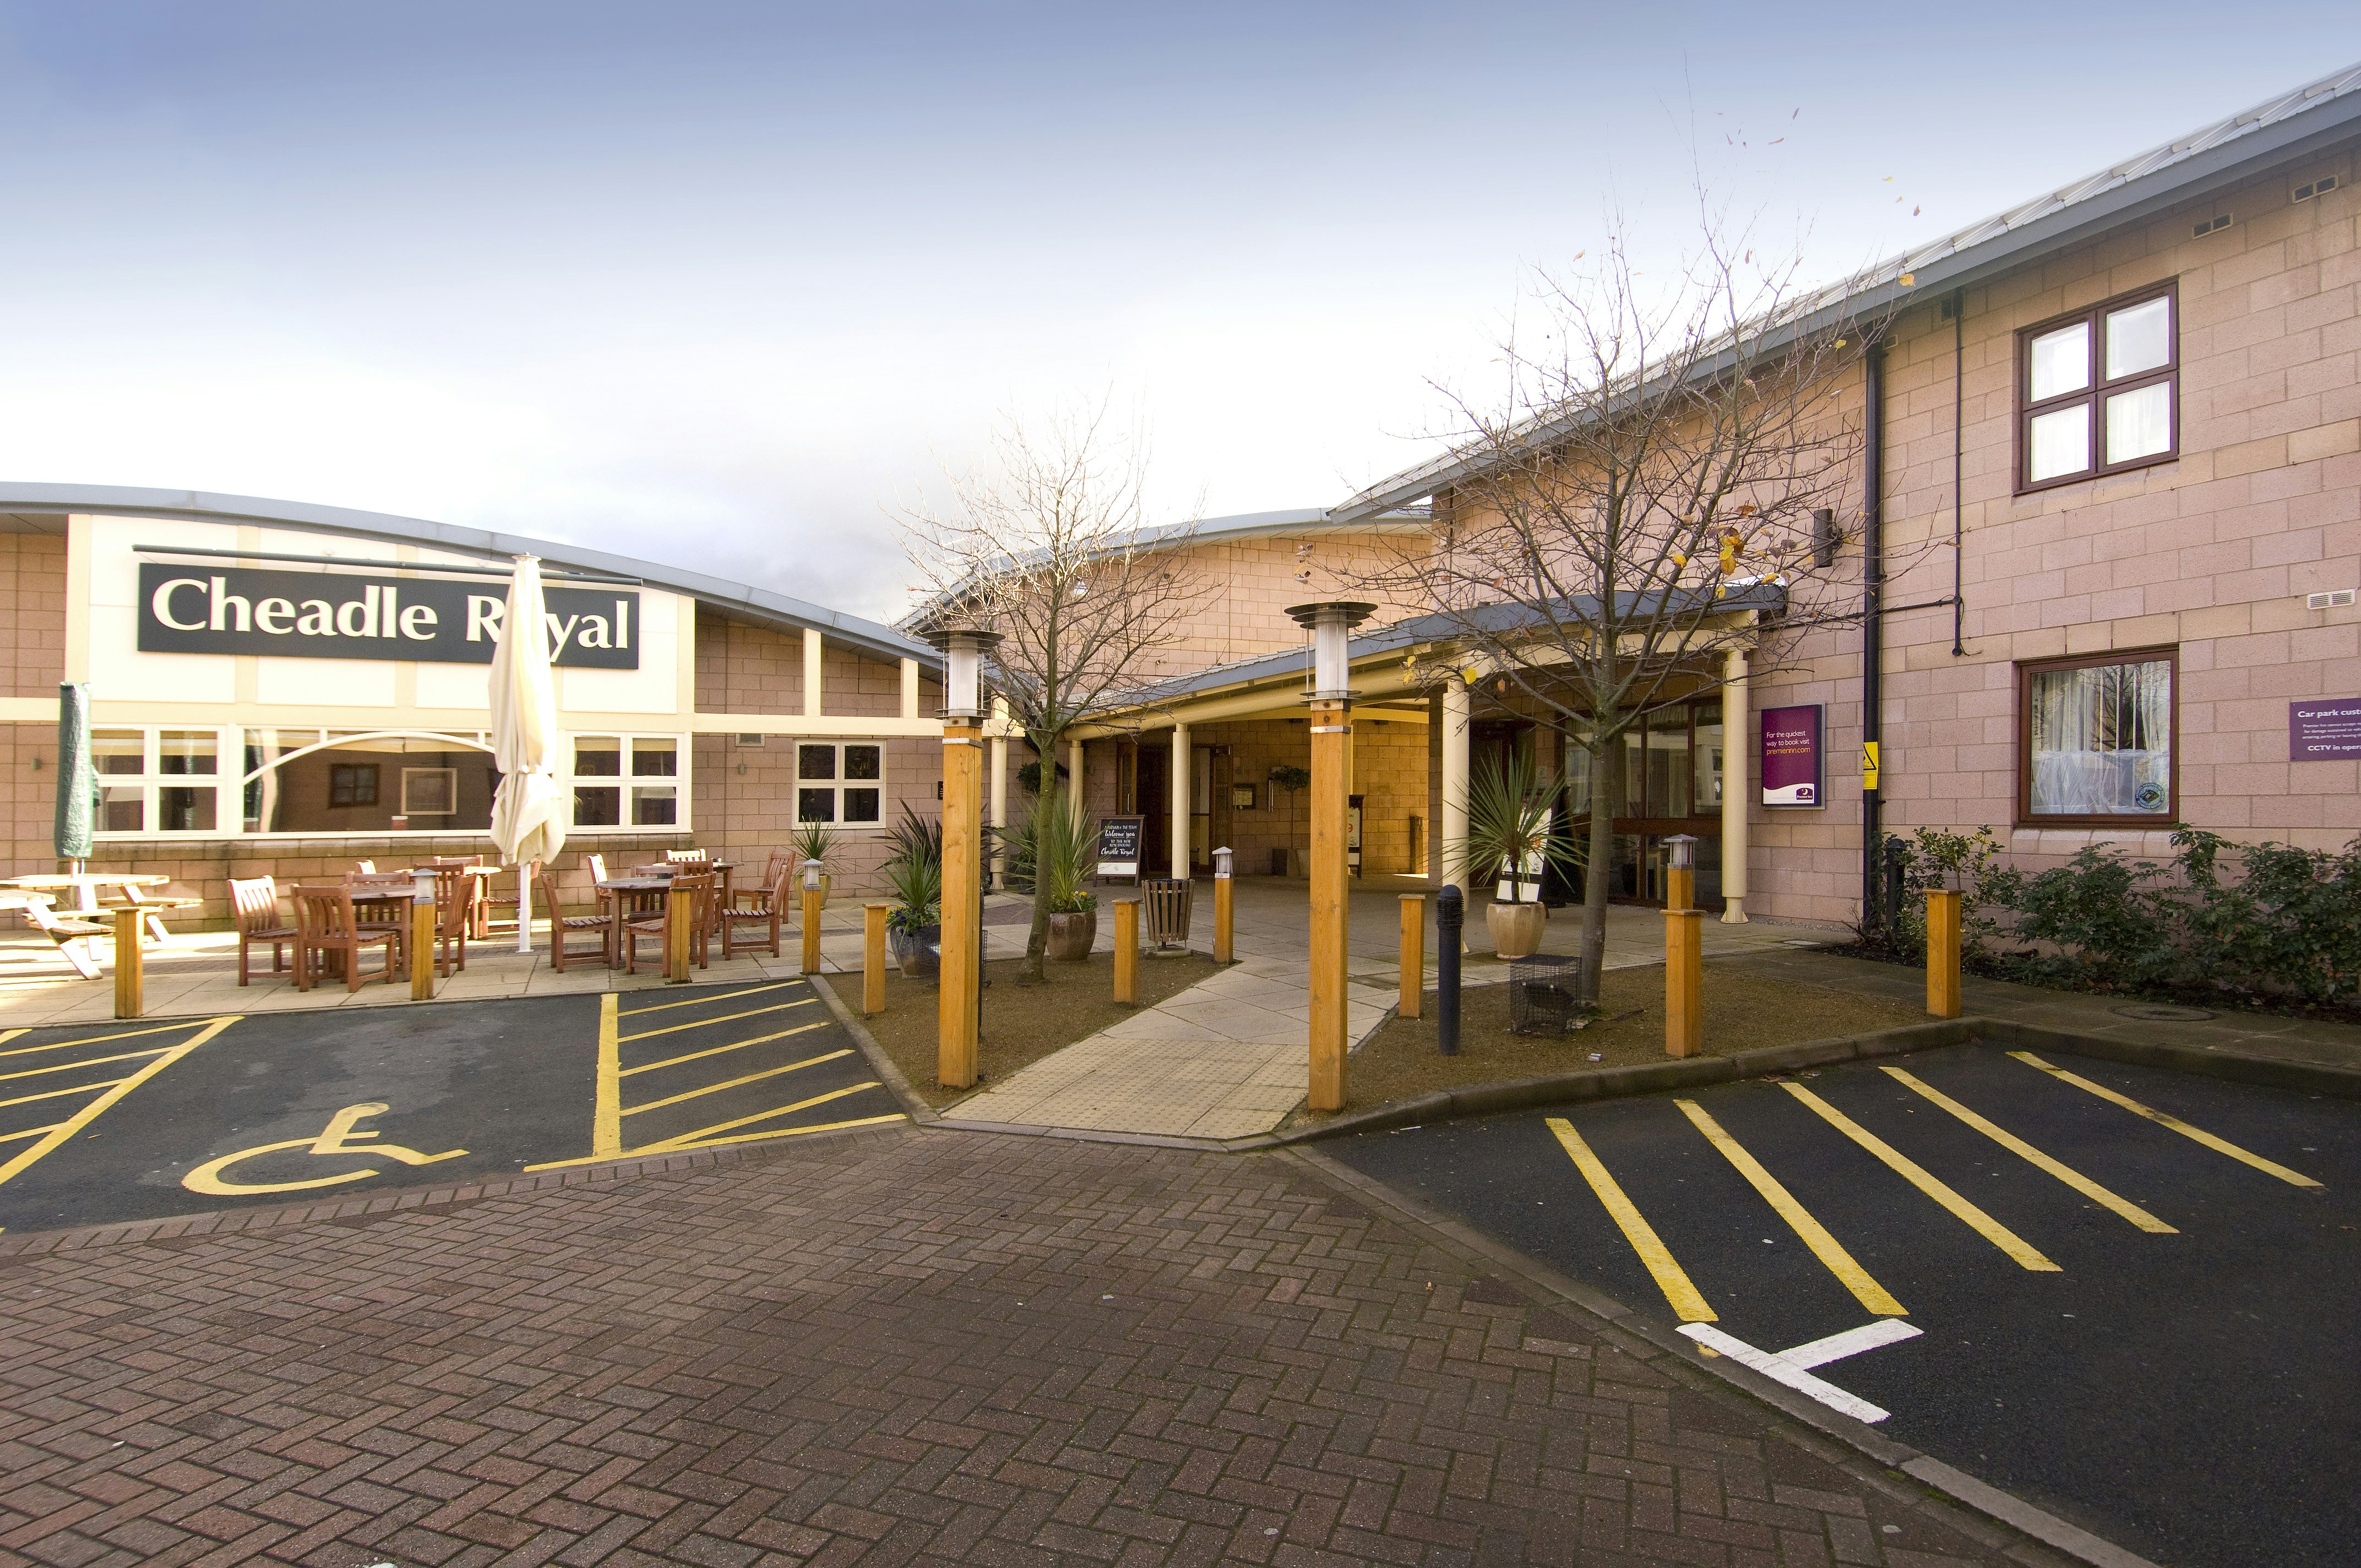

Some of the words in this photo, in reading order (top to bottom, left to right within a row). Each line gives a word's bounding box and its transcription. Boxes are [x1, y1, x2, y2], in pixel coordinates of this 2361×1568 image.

[151, 576, 438, 640] Cheadle
[465, 595, 629, 663] Ryal
[2317, 709, 2338, 718] park
